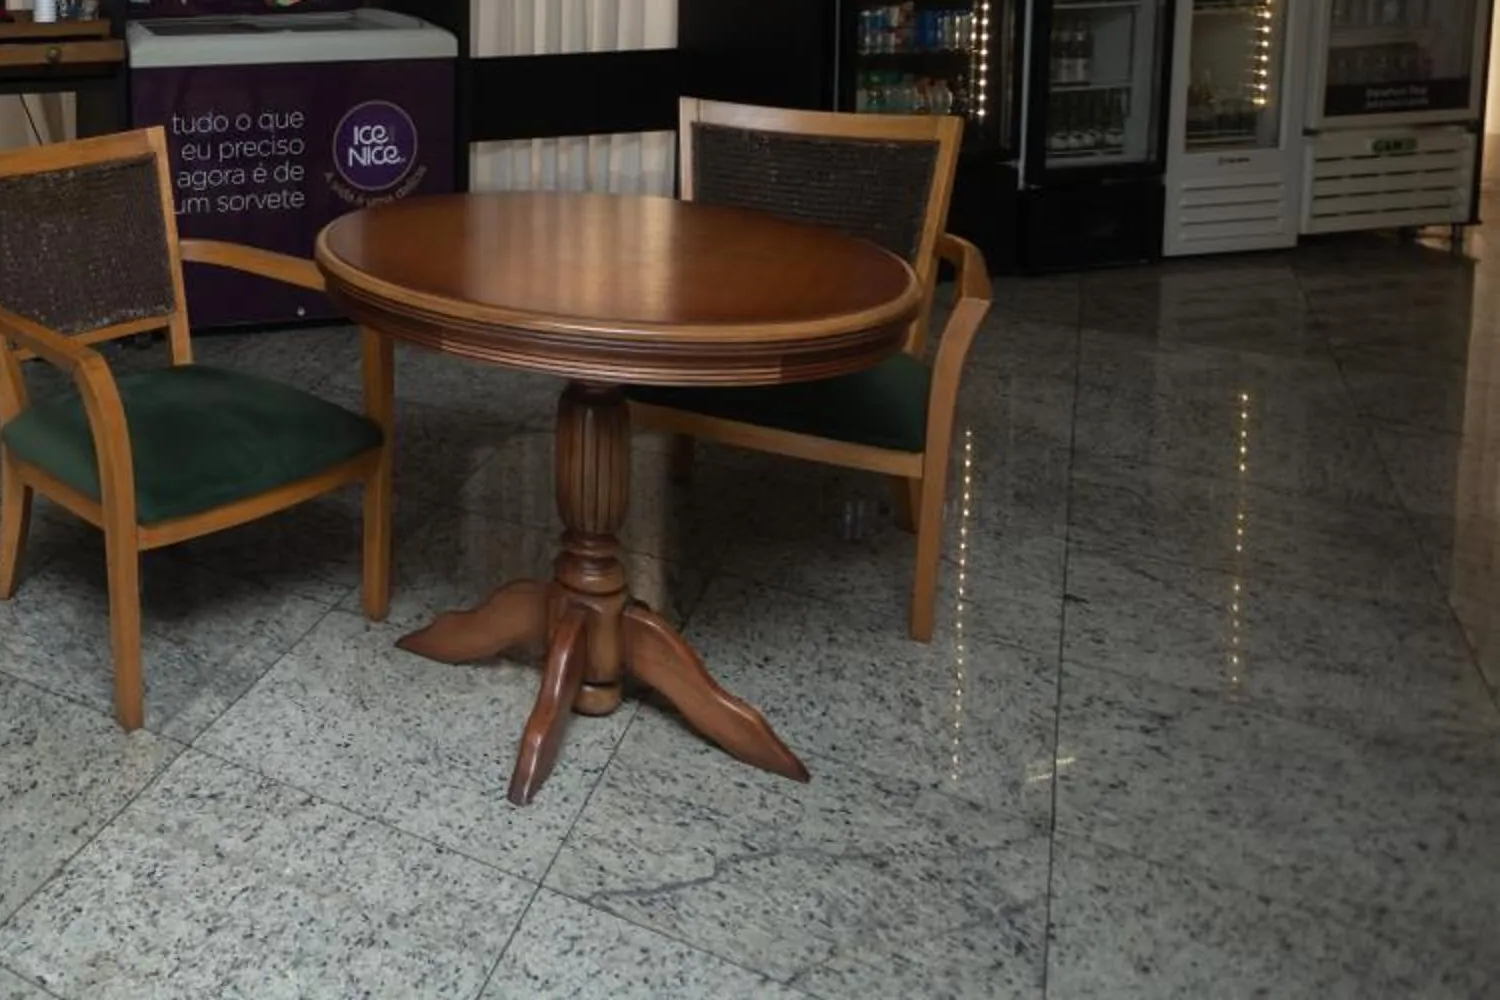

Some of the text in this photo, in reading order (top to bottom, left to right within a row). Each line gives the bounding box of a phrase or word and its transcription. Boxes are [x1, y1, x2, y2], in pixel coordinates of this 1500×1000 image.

[172, 110, 304, 135] tudo o que
[181, 134, 305, 163] eu preciso
[177, 159, 305, 191] agora é de
[217, 189, 305, 213] sorvete
